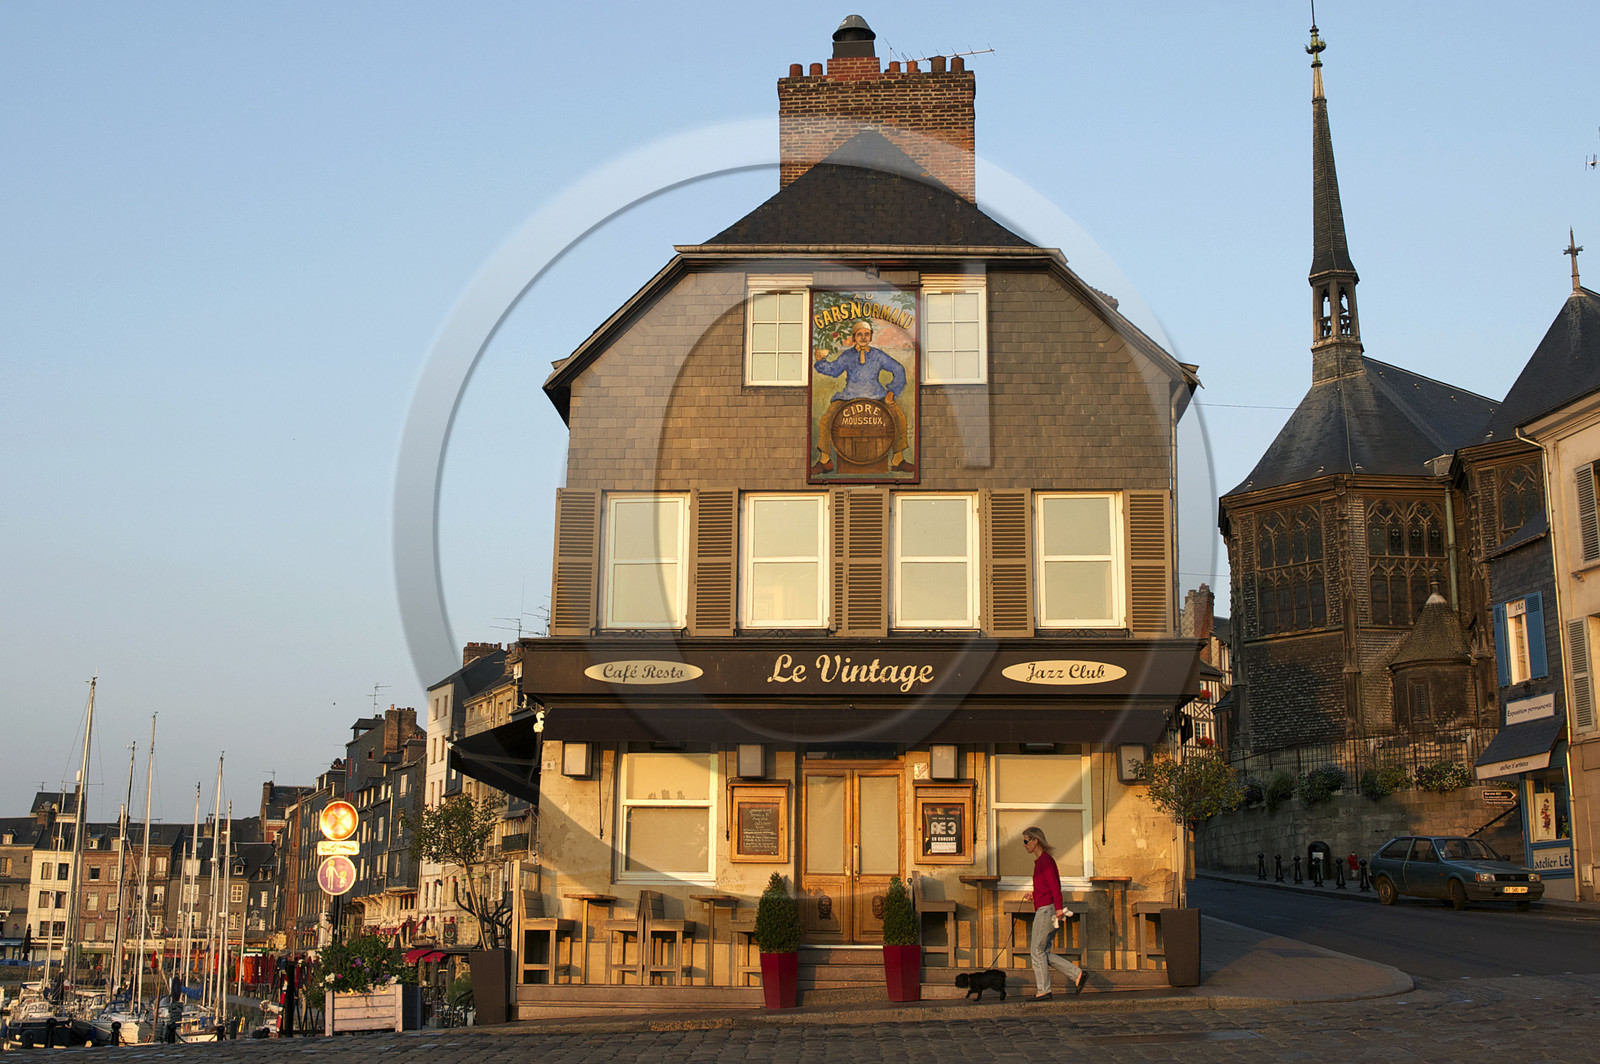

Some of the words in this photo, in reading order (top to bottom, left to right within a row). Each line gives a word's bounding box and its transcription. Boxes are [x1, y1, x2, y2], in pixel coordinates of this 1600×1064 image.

[814, 303, 849, 330] GARS
[849, 300, 915, 330] NORMAND
[842, 403, 881, 417] CIDRE
[602, 663, 638, 683] Café
[767, 653, 807, 683] Le
[815, 653, 934, 693] Vintage
[1025, 662, 1065, 682] Jazz
[1068, 663, 1106, 679] Club
[1534, 856, 1557, 869] atelier
